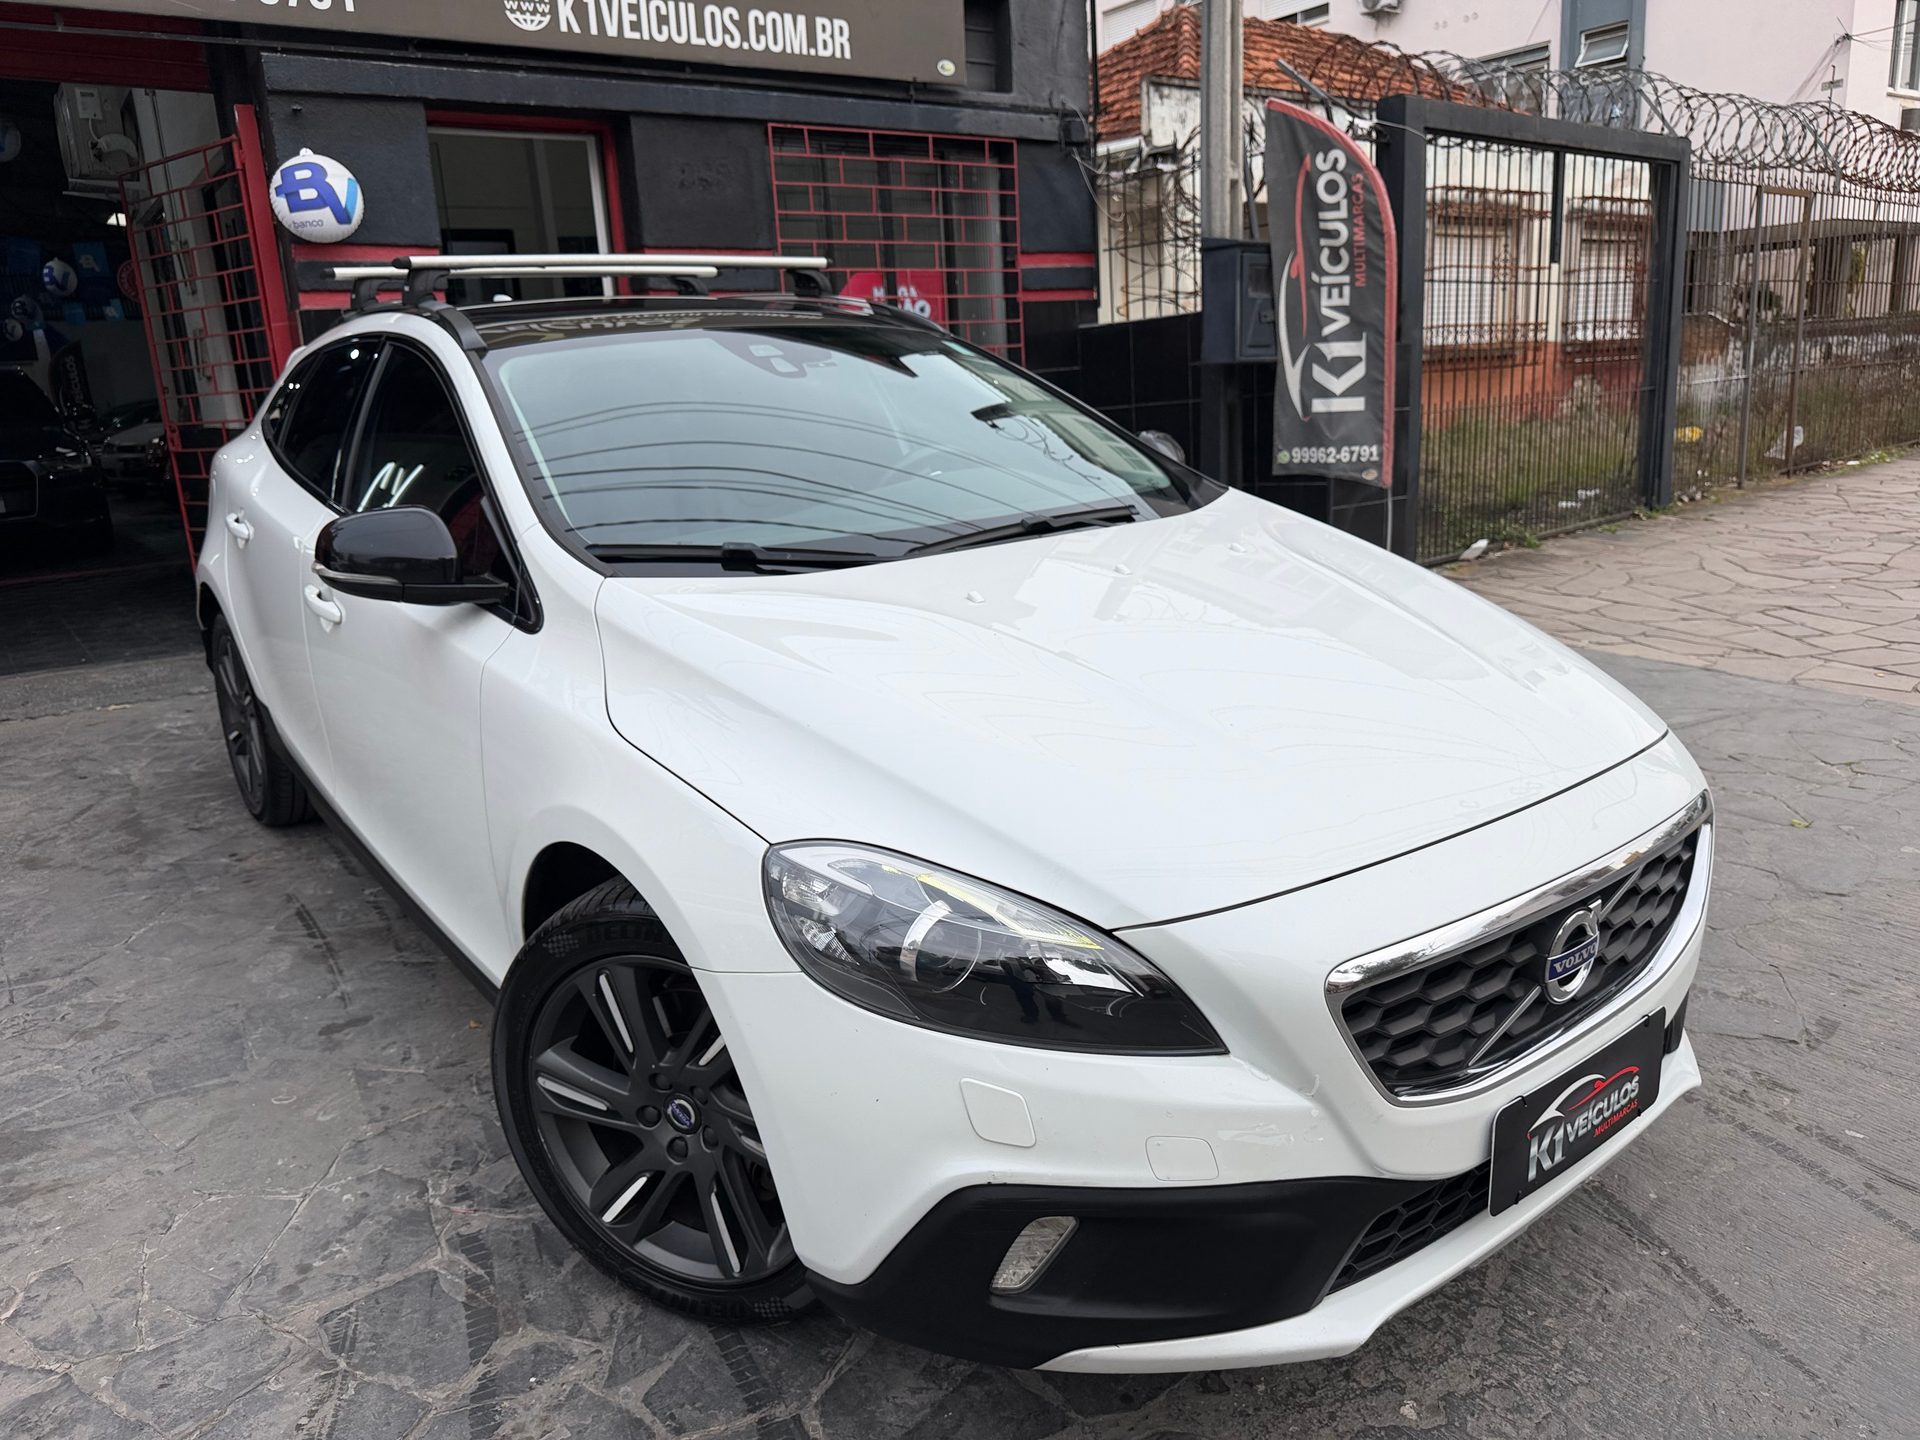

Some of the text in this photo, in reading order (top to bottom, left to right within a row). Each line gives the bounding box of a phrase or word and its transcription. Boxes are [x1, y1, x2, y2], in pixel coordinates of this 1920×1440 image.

[275, 162, 358, 225] BV
[293, 219, 324, 229] banco
[1351, 172, 1367, 288] MULTIMARCAS
[1311, 148, 1367, 413] K1 VEÍCULOS
[1291, 444, 1380, 464] 99962-6791
[1553, 942, 1597, 973] VOLVO
[1527, 1075, 1640, 1183] K1 VEÍCULOS
[1593, 1099, 1639, 1137] MULTIMARCAS
